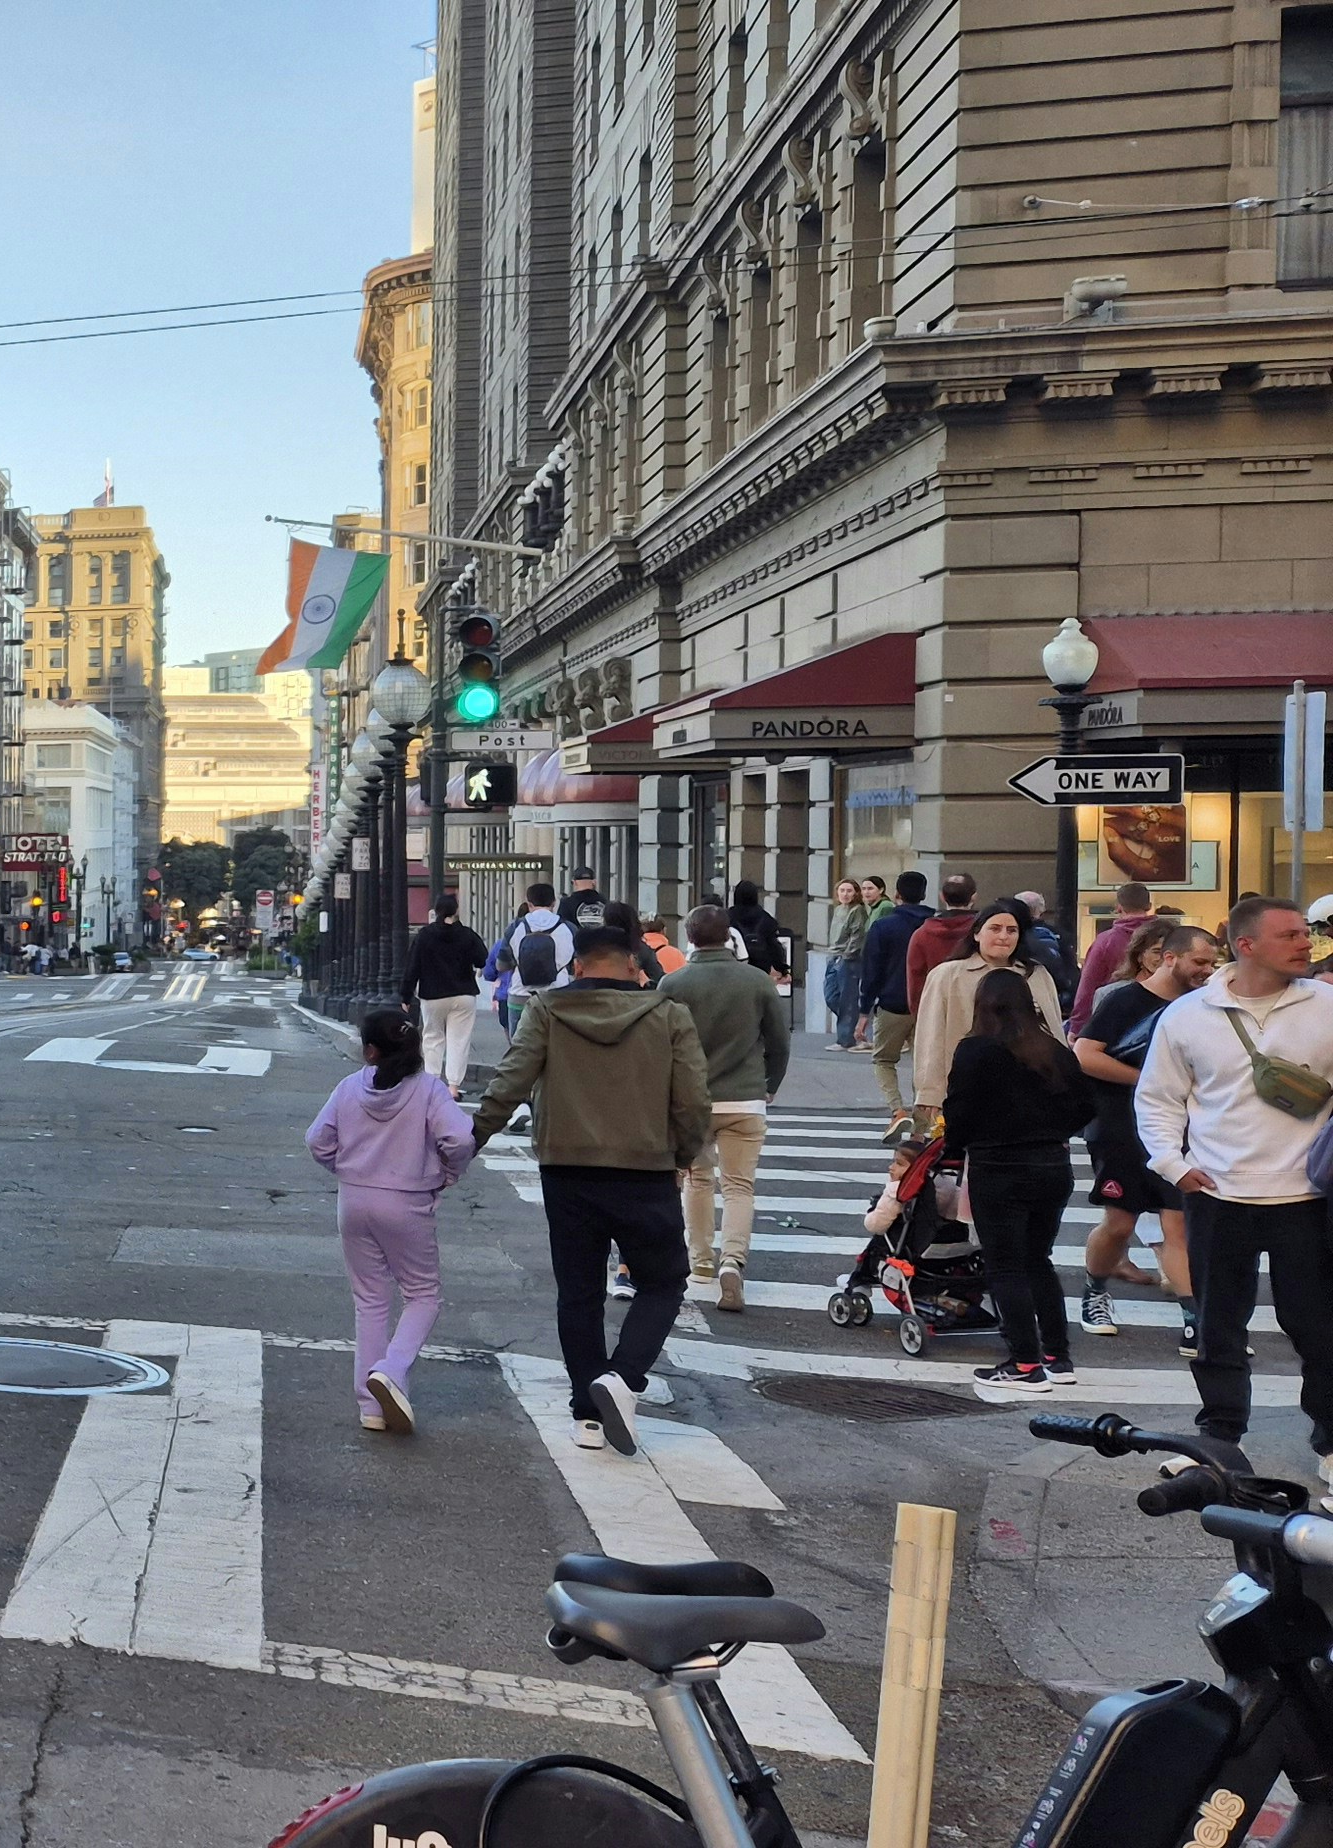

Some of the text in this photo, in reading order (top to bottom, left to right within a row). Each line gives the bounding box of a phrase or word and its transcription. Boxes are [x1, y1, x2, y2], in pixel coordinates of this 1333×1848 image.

[751, 717, 869, 738] PANDORA
[479, 735, 525, 746] Post
[1058, 771, 1162, 790] ONE WAY
[313, 769, 321, 854] HERBERT
